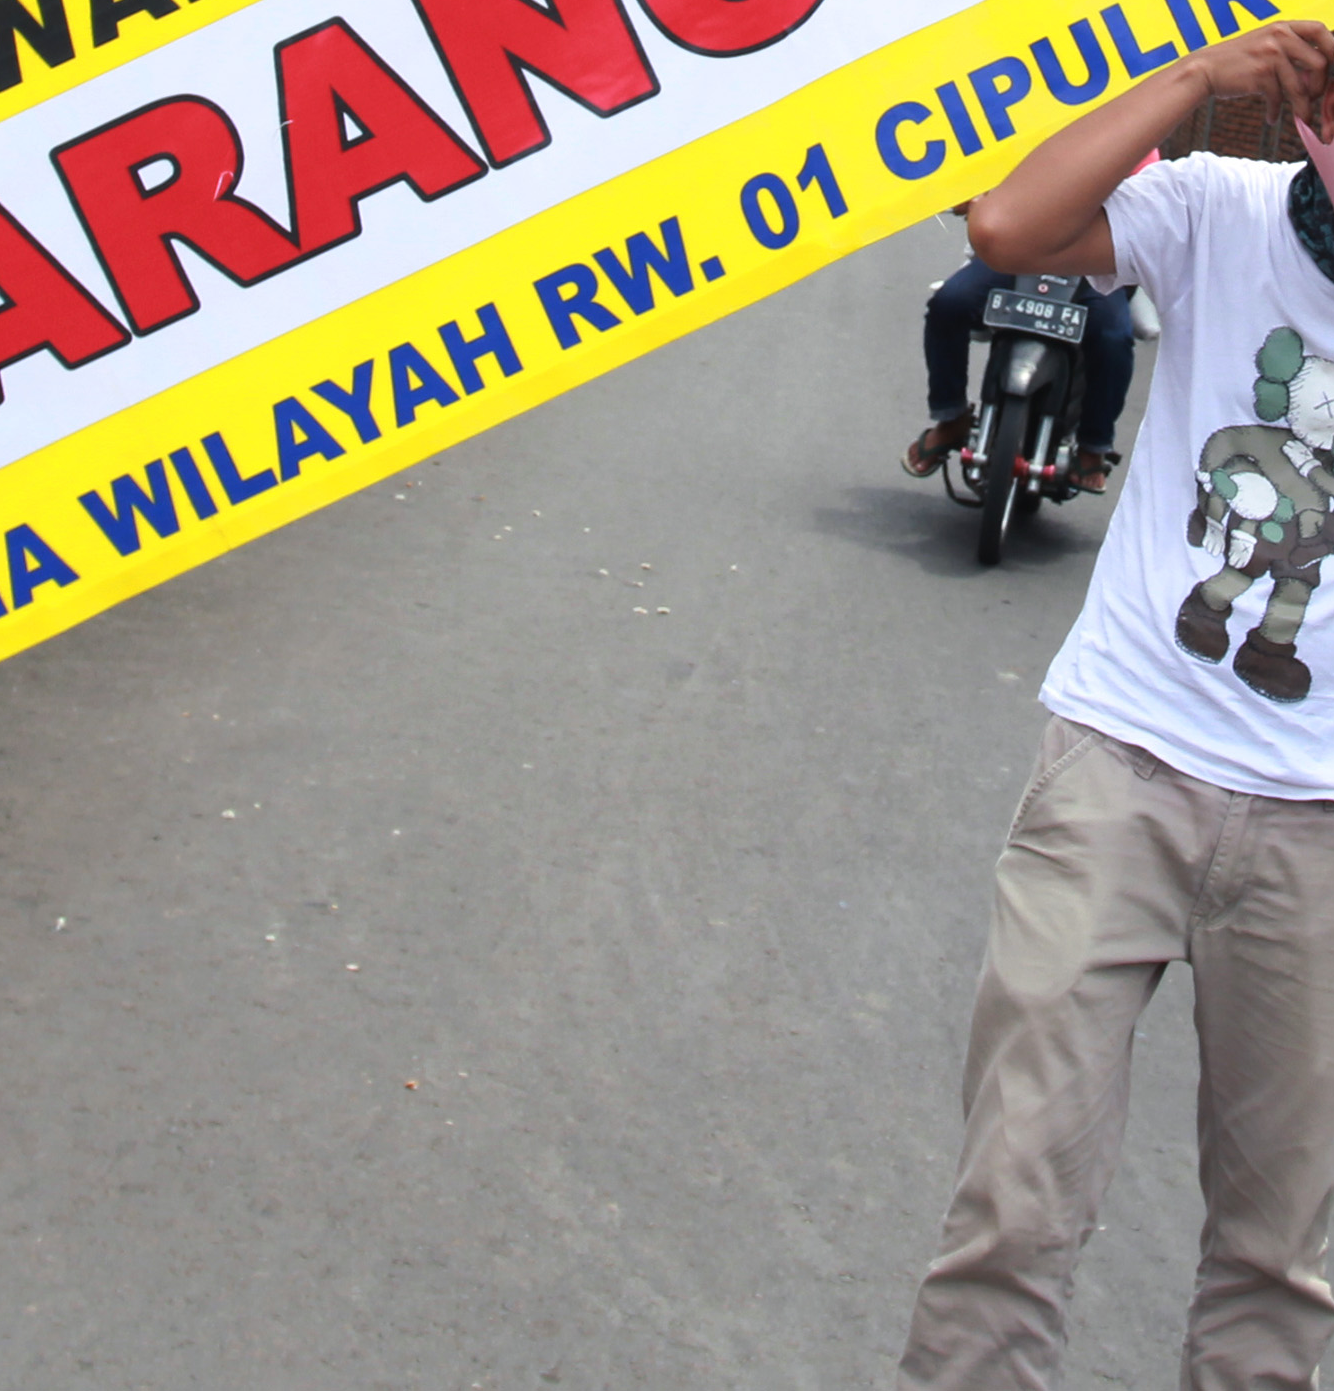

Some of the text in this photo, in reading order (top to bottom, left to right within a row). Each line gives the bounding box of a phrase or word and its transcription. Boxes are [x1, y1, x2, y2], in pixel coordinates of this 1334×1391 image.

[77, 301, 523, 554] WILAYAH
[533, 216, 727, 350] RW.
[739, 143, 849, 249] 01
[992, 294, 1002, 309] B
[1016, 298, 1055, 320] 4908
